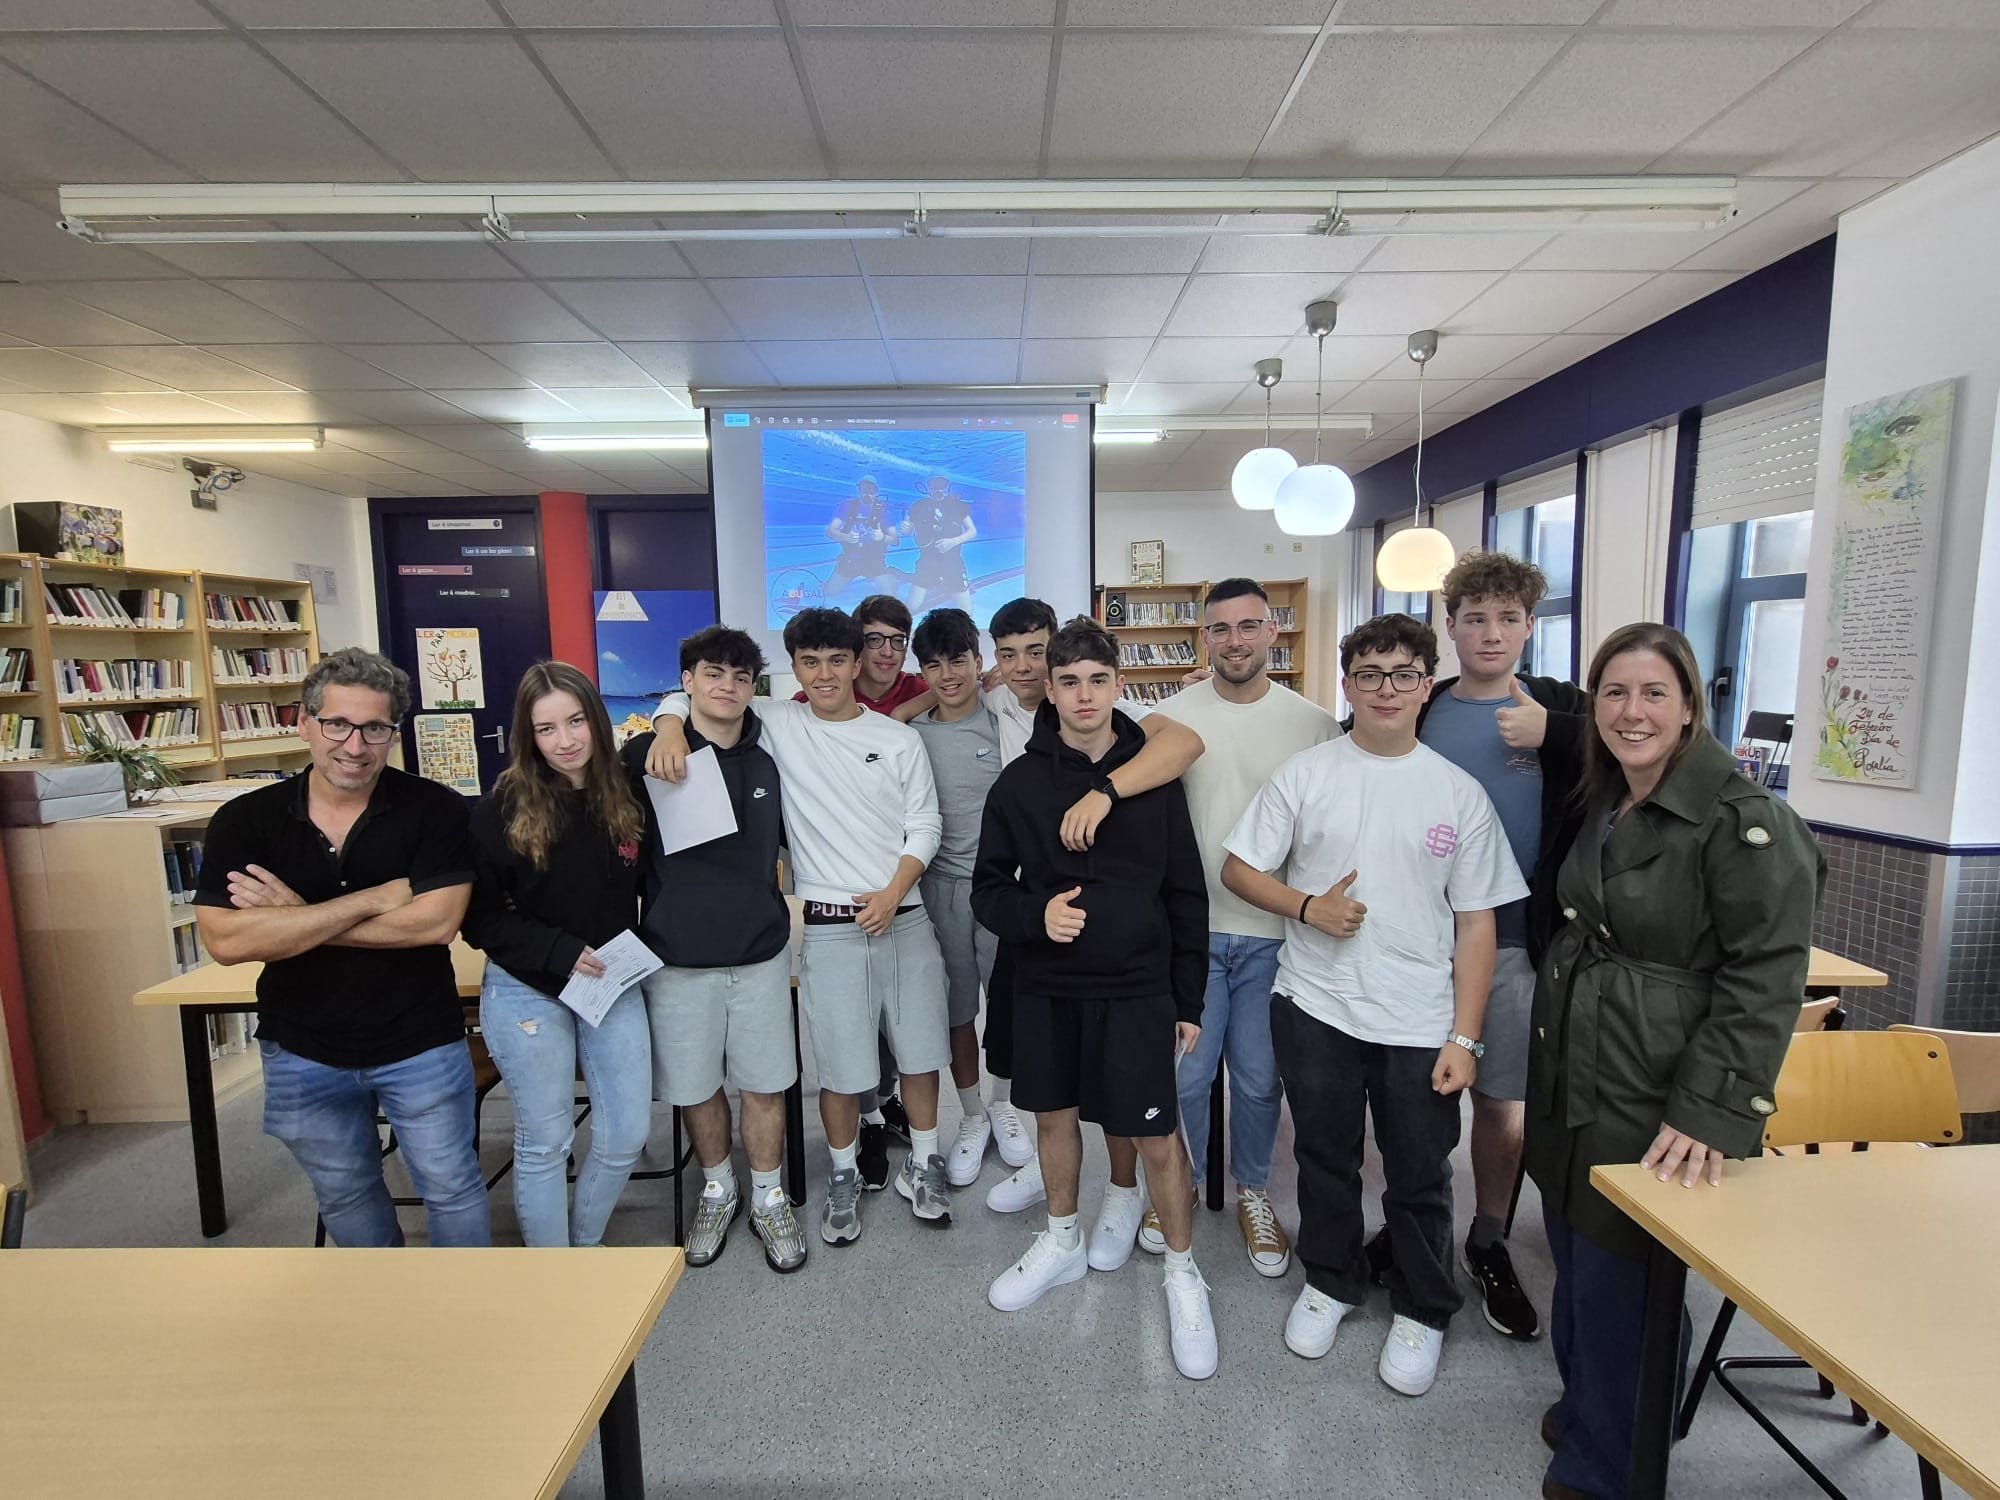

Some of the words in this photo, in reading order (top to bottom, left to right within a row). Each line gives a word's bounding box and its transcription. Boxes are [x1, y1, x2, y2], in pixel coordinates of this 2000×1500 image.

[430, 629, 448, 648] PARA
[1856, 707, 1873, 720] 24
[1878, 705, 1896, 721] de
[1886, 734, 1901, 749] de
